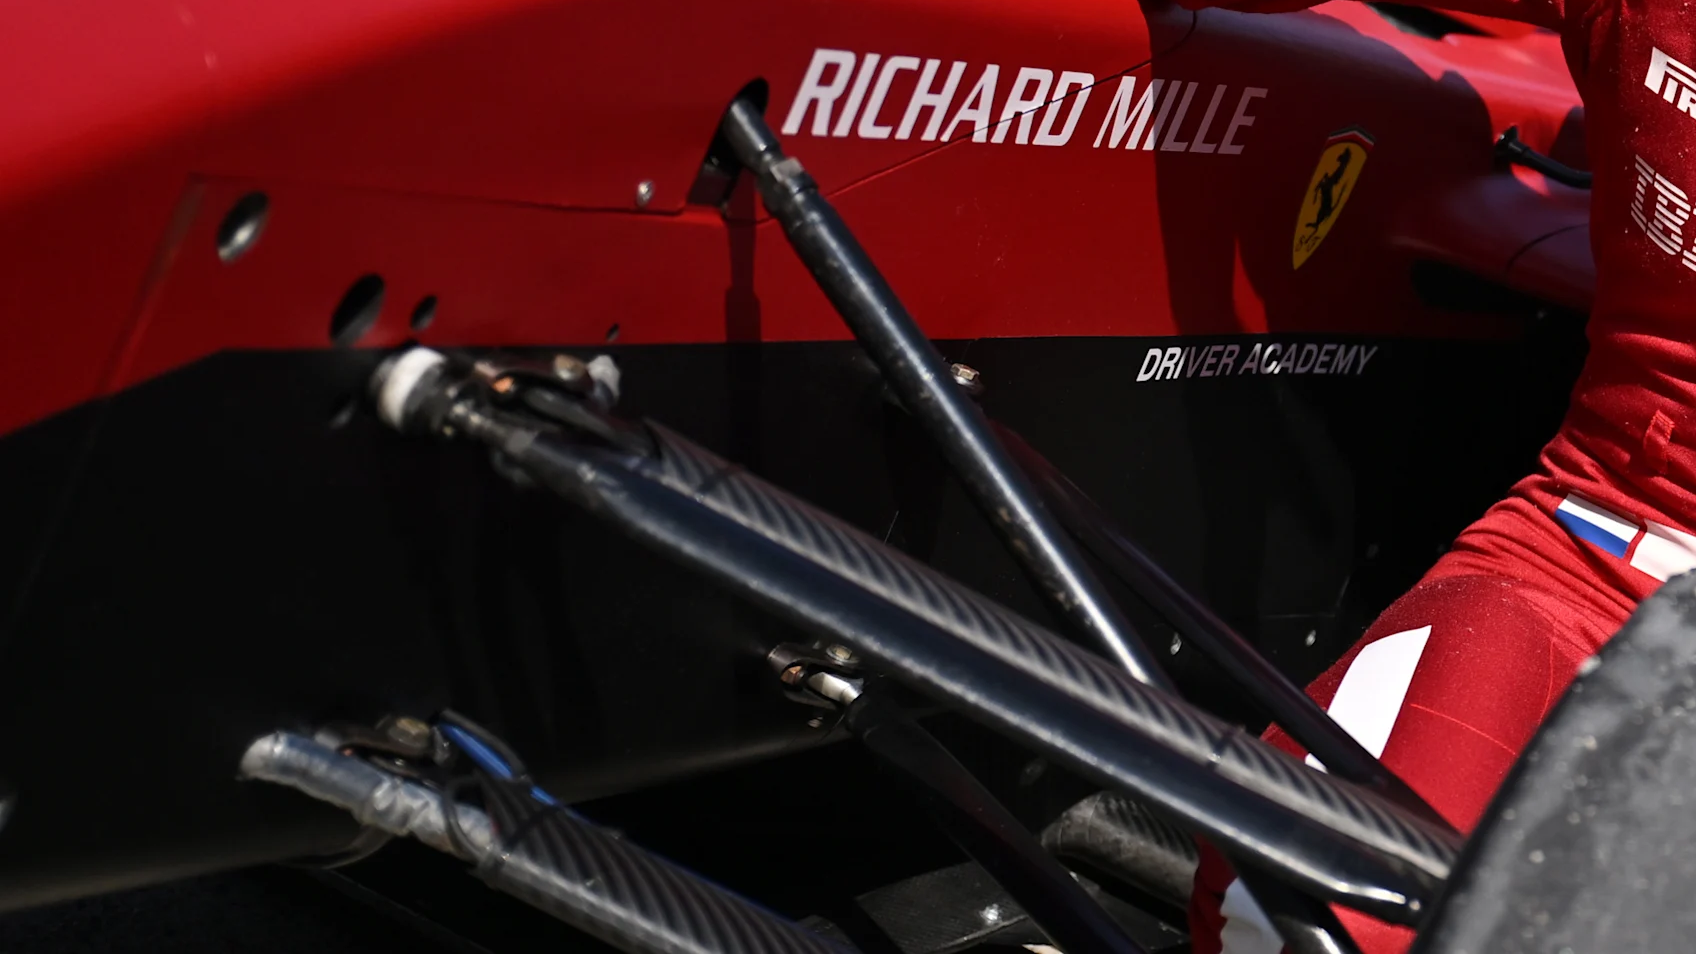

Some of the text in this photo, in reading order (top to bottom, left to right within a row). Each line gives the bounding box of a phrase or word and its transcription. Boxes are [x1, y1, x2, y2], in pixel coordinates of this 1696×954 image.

[783, 48, 1268, 155] RICHARD MILLE
[1136, 343, 1377, 382] DRIVER ACADEMY
